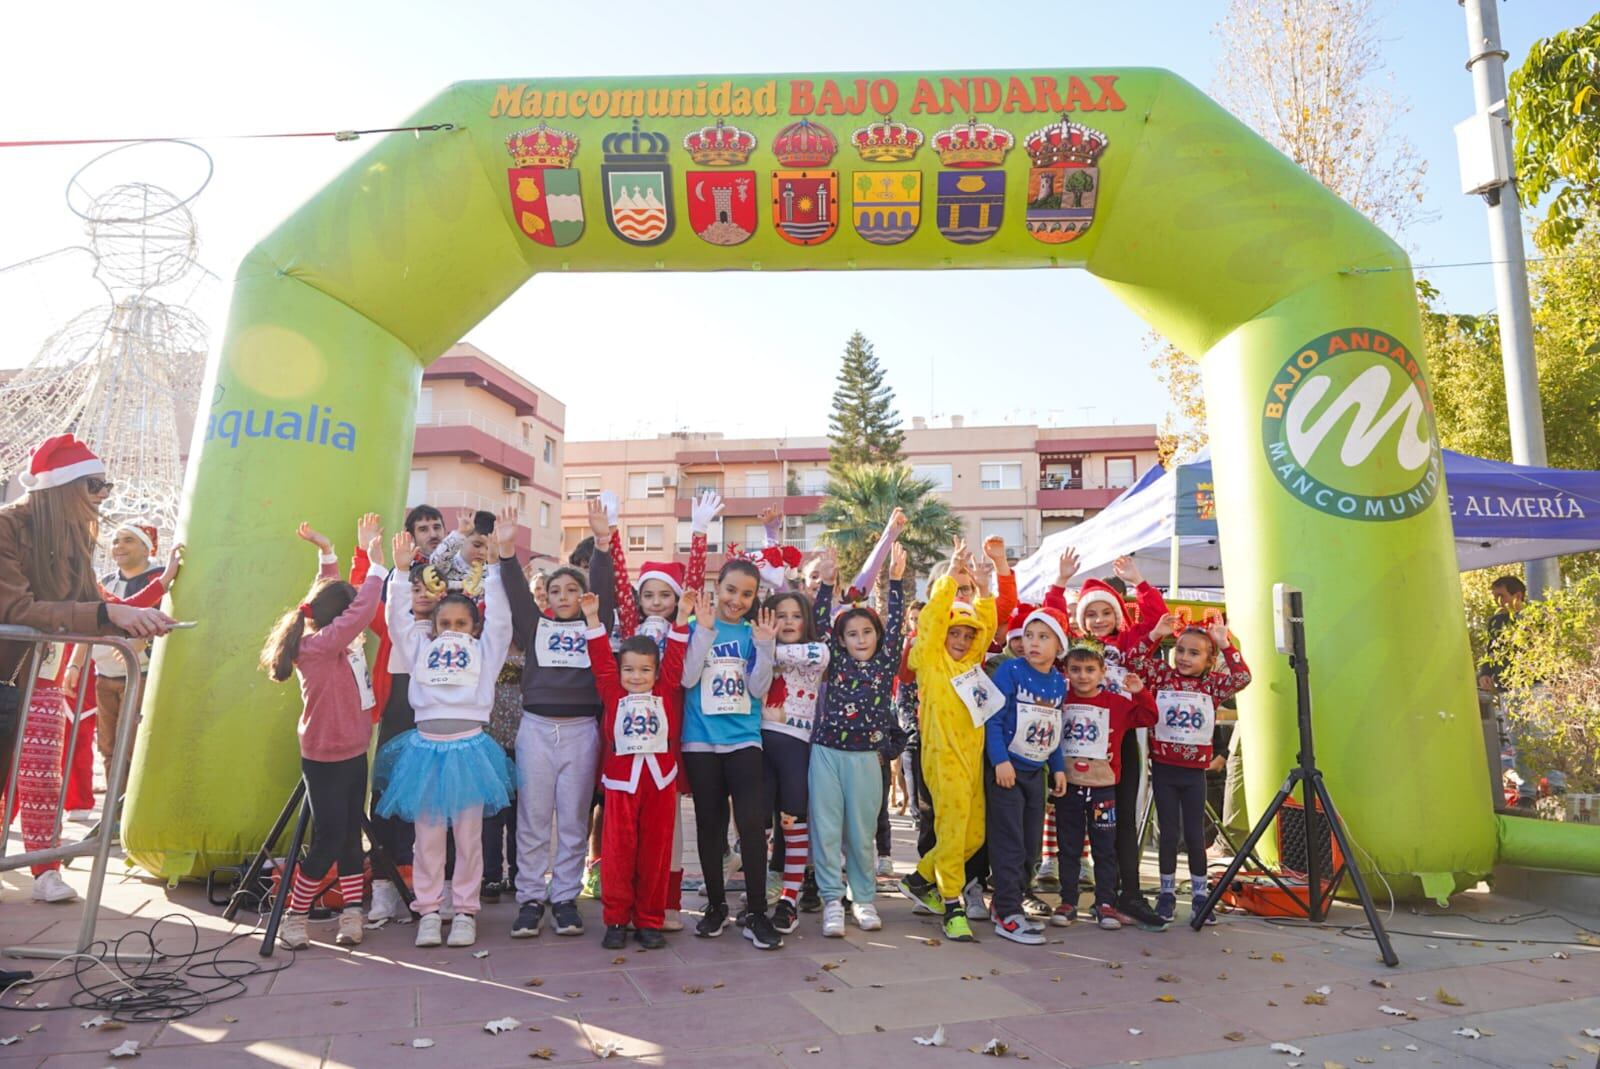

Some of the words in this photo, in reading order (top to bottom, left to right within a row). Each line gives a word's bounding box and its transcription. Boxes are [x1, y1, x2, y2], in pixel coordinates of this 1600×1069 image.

[489, 80, 778, 119] Mancomunidad
[788, 78, 898, 116] BAJO
[910, 74, 1127, 115] ANDARAX
[1264, 349, 1319, 419] BAJO
[1464, 492, 1585, 519] ALMERÍA
[548, 635, 586, 654] 232
[428, 650, 468, 669] 213
[712, 678, 745, 697] 209
[623, 715, 658, 736] 235
[1166, 709, 1203, 730] 226
[1064, 723, 1097, 742] 233
